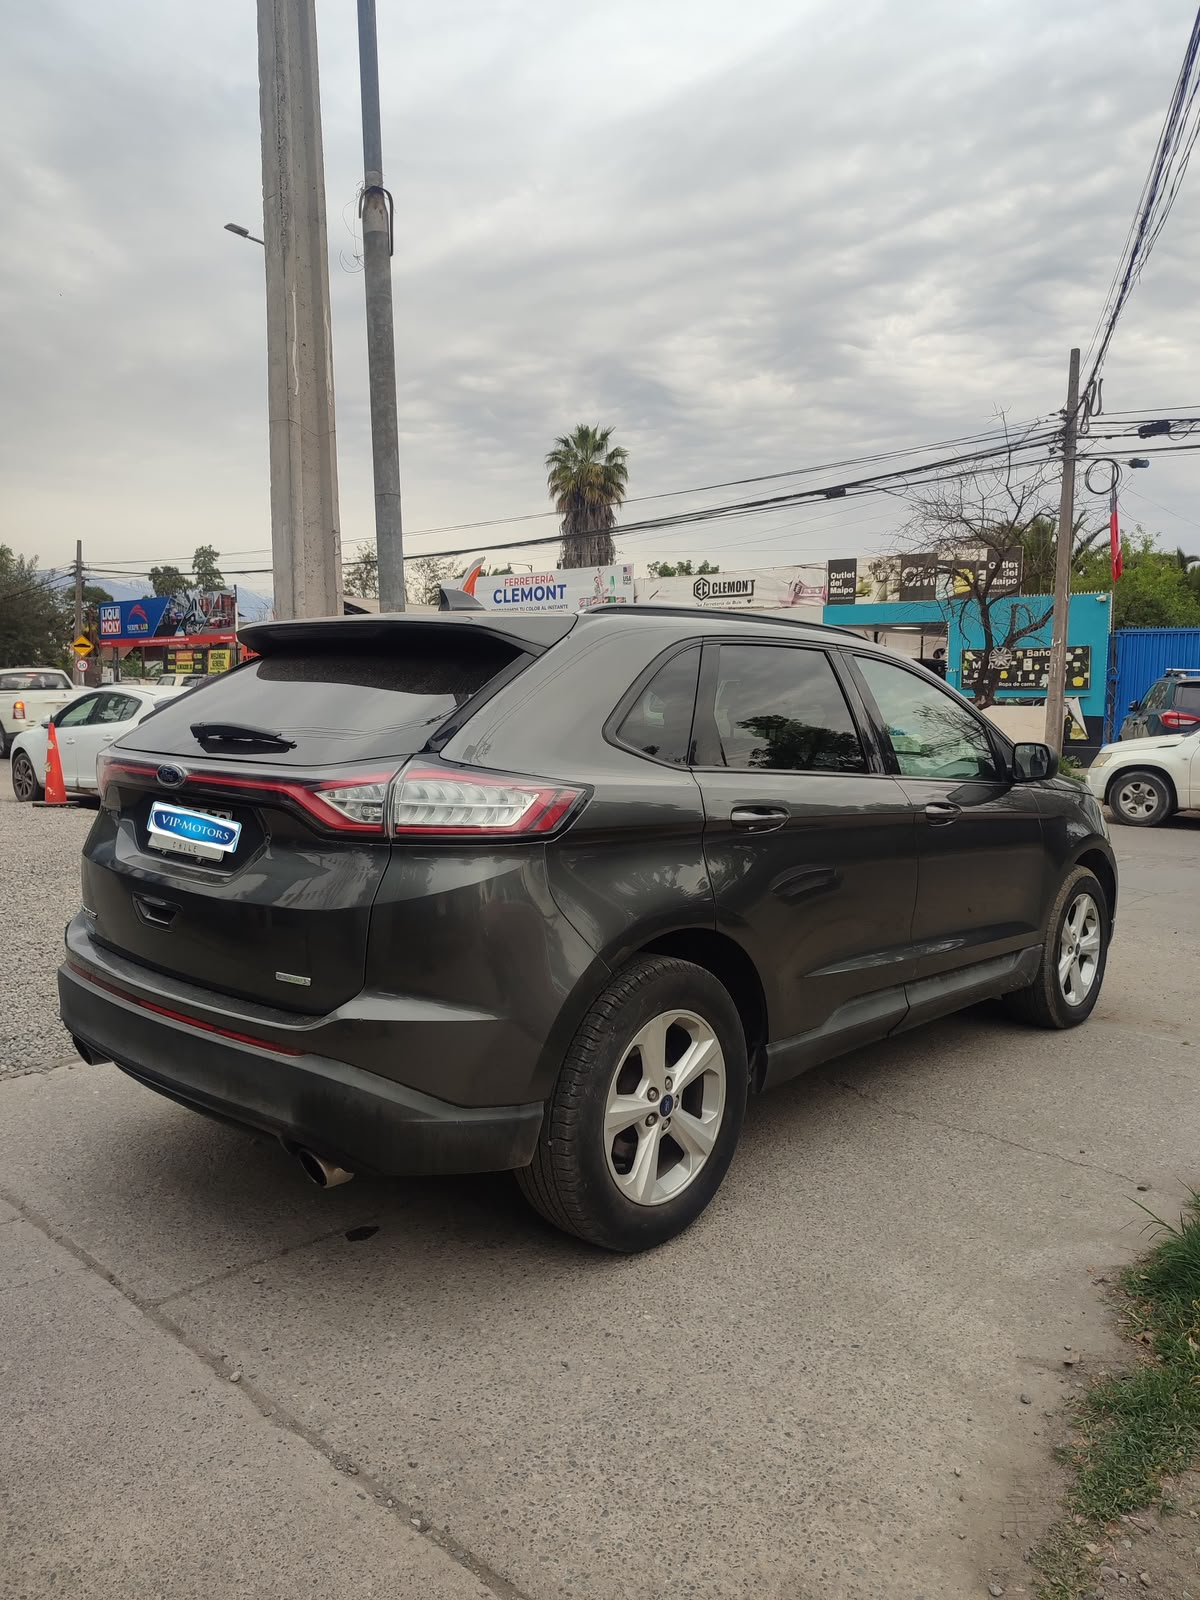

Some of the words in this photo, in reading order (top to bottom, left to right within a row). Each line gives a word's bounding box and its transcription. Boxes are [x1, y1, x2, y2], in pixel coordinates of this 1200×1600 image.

[988, 560, 1019, 569] Otlet
[504, 573, 555, 587] FERRETERÍA
[830, 571, 855, 579] Outlet
[712, 579, 756, 596] CLEMONT
[830, 579, 843, 587] del
[493, 584, 567, 605] CLEMONT
[830, 586, 854, 595] Maipo
[102, 620, 120, 633] MOLY
[172, 841, 198, 853] CHILE
